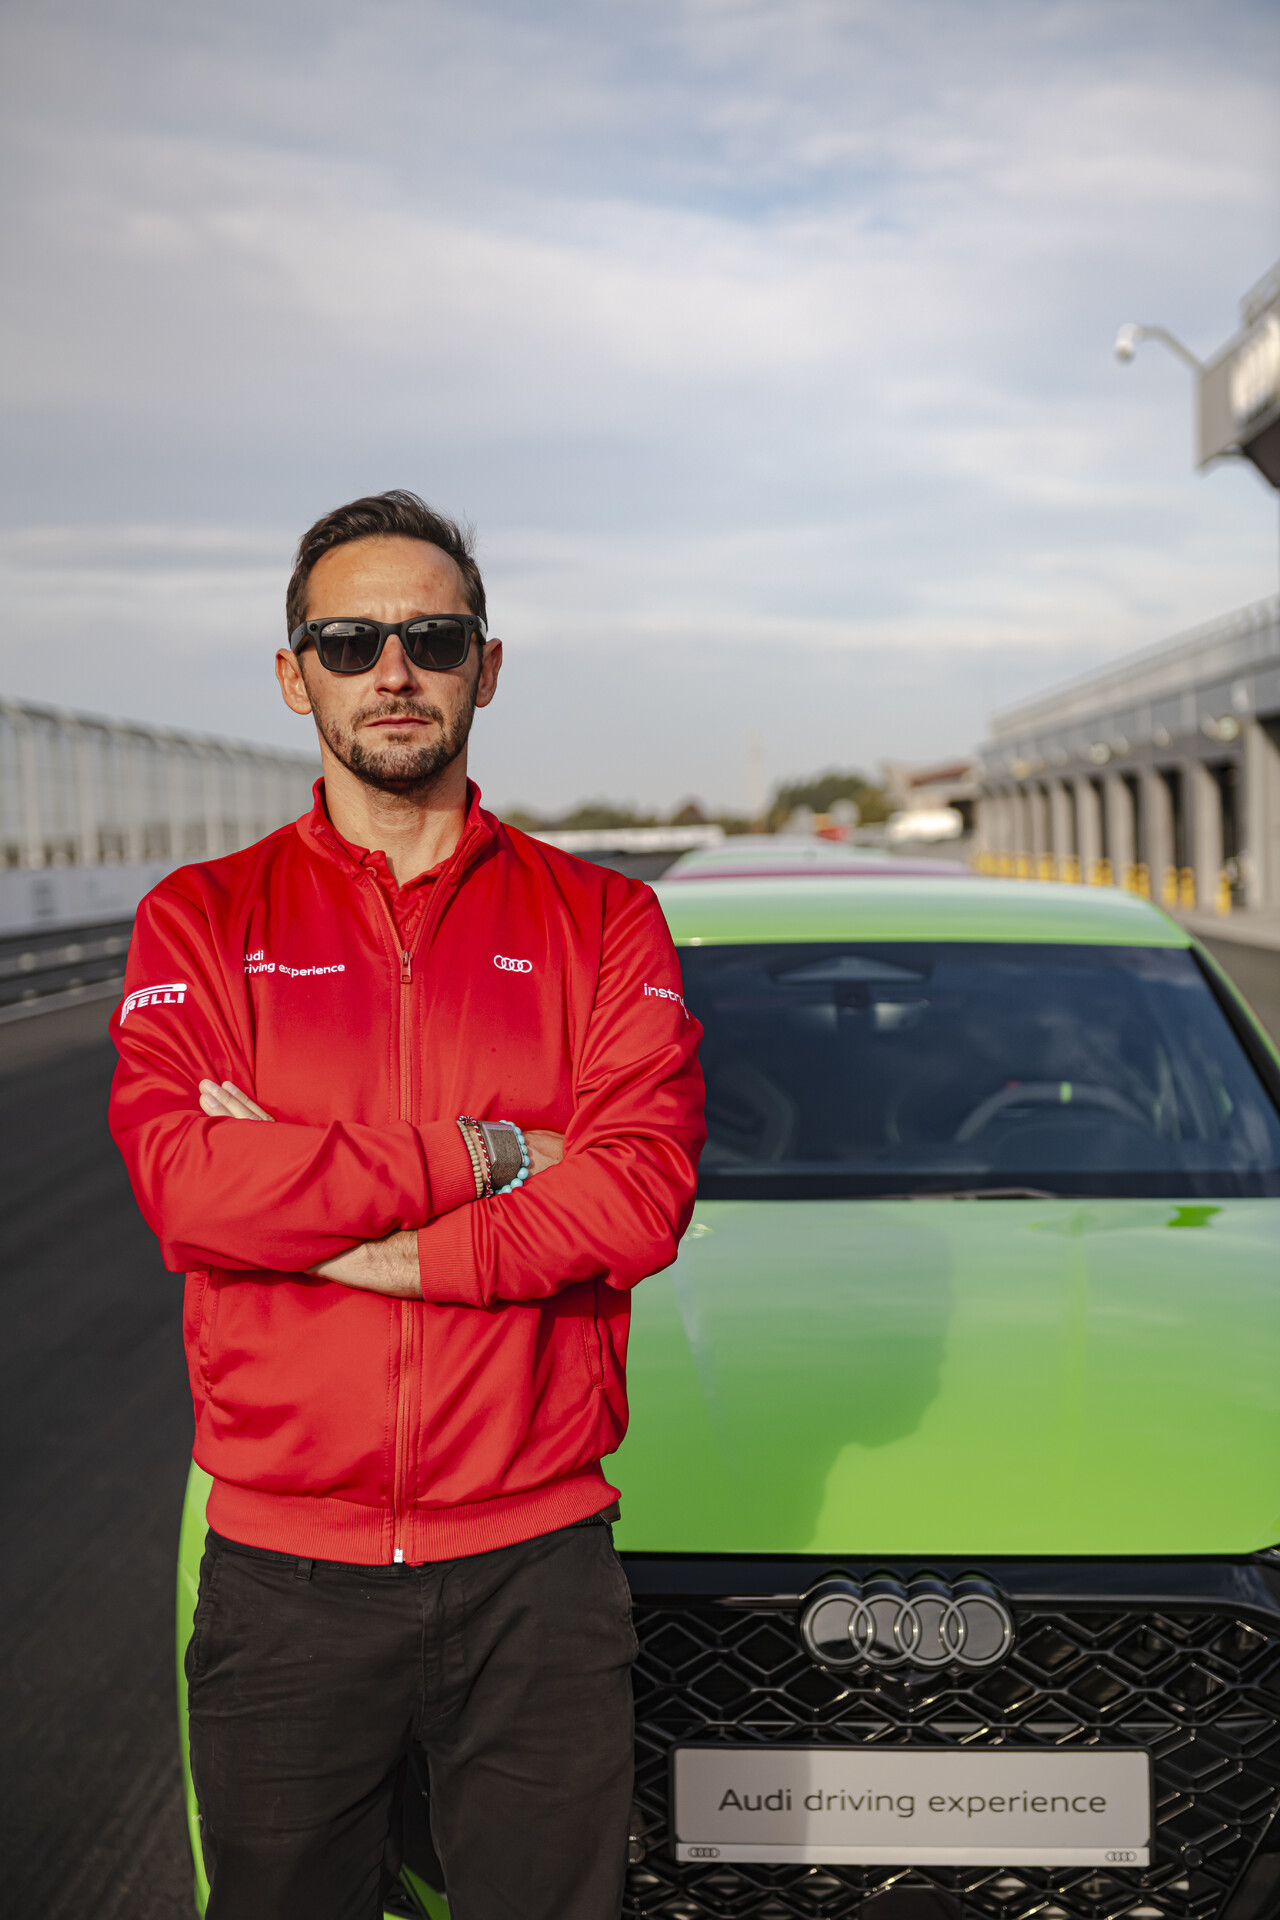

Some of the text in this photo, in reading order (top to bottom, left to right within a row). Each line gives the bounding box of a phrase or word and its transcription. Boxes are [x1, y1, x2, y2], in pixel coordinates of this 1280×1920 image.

[243, 950, 264, 962] udi
[244, 962, 346, 978] riving experience
[718, 1788, 1107, 1818] Audi driving experience
